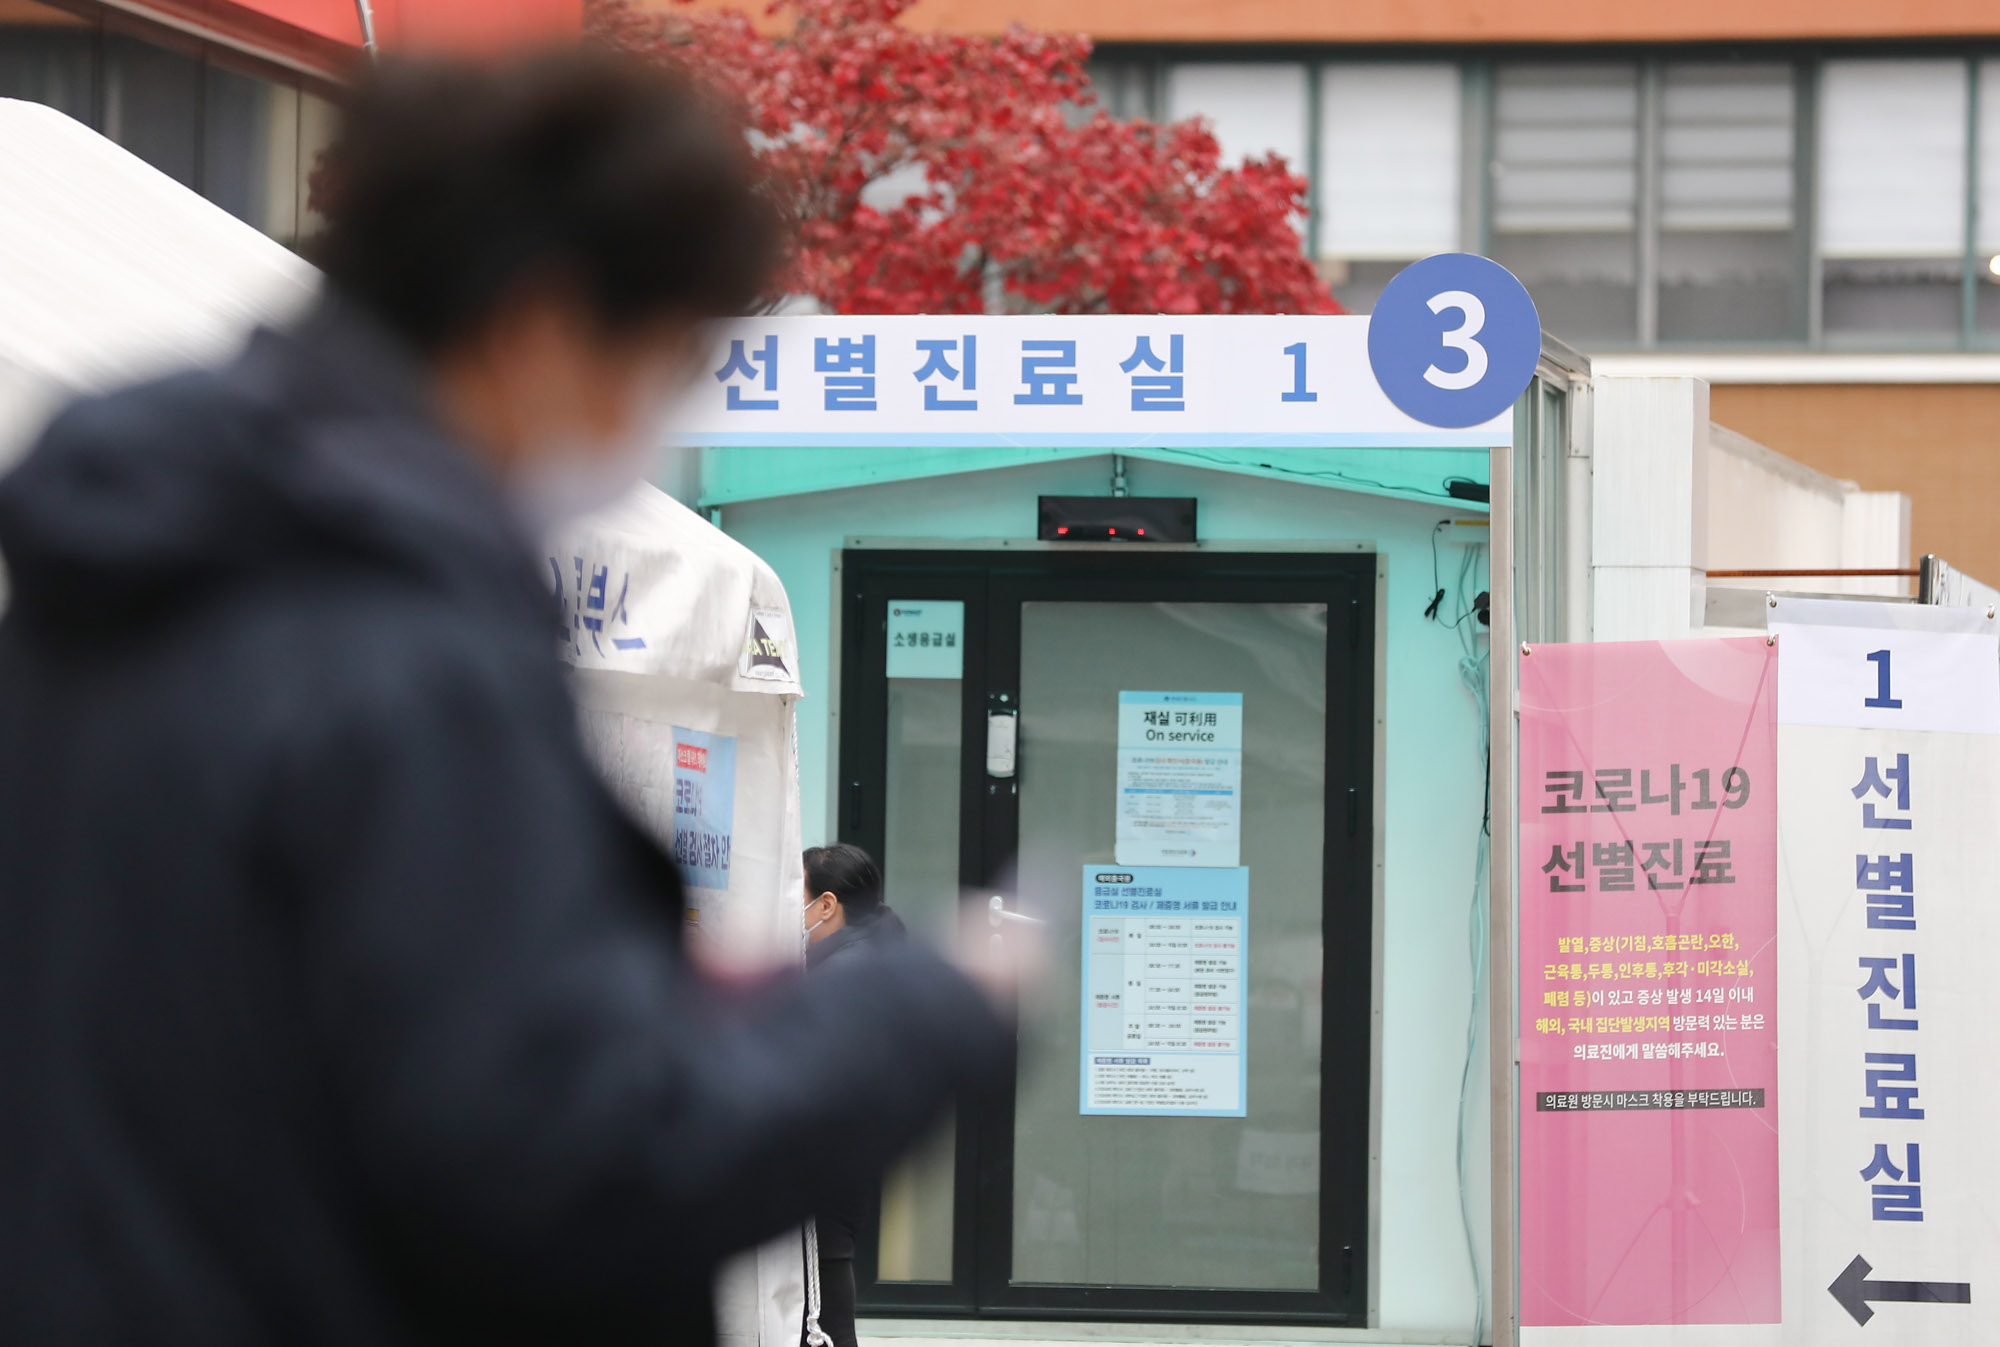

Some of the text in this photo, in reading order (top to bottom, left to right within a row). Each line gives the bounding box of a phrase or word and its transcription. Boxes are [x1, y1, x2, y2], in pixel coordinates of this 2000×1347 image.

[1422, 289, 1490, 391] 3
[714, 333, 1318, 412] 선별진료실 1
[1864, 649, 1903, 709] 1
[1144, 711, 1217, 726] 재실 可利用
[1146, 729, 1215, 742] On service
[1541, 763, 1751, 816] 코로나19
[1541, 838, 1737, 893] 선별진료
[1544, 991, 1569, 1007] 폐렴
[1608, 989, 1634, 1006] 있고
[1637, 988, 1663, 1006] 증상
[1666, 987, 1692, 1004] 발생
[1695, 987, 1724, 1004] 14일
[1728, 986, 1754, 1003] 이내
[1851, 752, 1925, 1222] 선별진료실
[1536, 1013, 1765, 1036] 해외, 국내 집단발생지역 방문력 있는 분은
[1573, 1041, 1725, 1061] 의료진에게 말씀해주세요.
[1546, 1091, 1757, 1110] 의료원 방문시 마스크 착용을 부탁드립니다.
